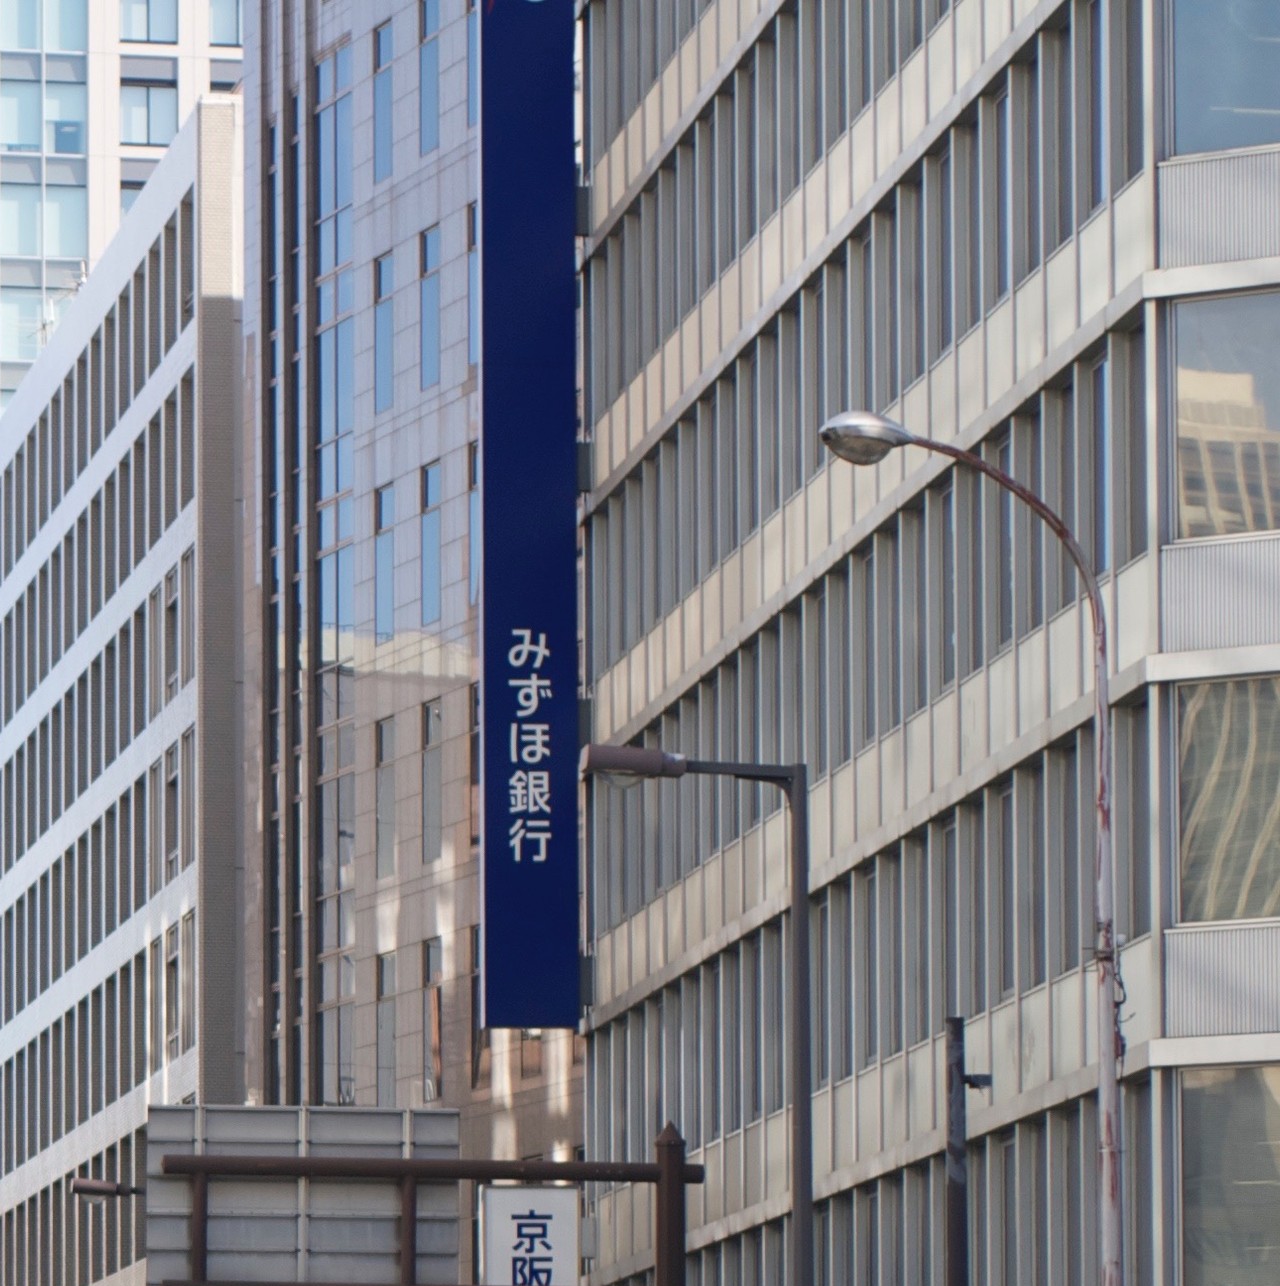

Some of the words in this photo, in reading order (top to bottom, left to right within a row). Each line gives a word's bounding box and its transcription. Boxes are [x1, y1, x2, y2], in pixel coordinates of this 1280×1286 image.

[507, 628, 553, 862] みずほ銀行
